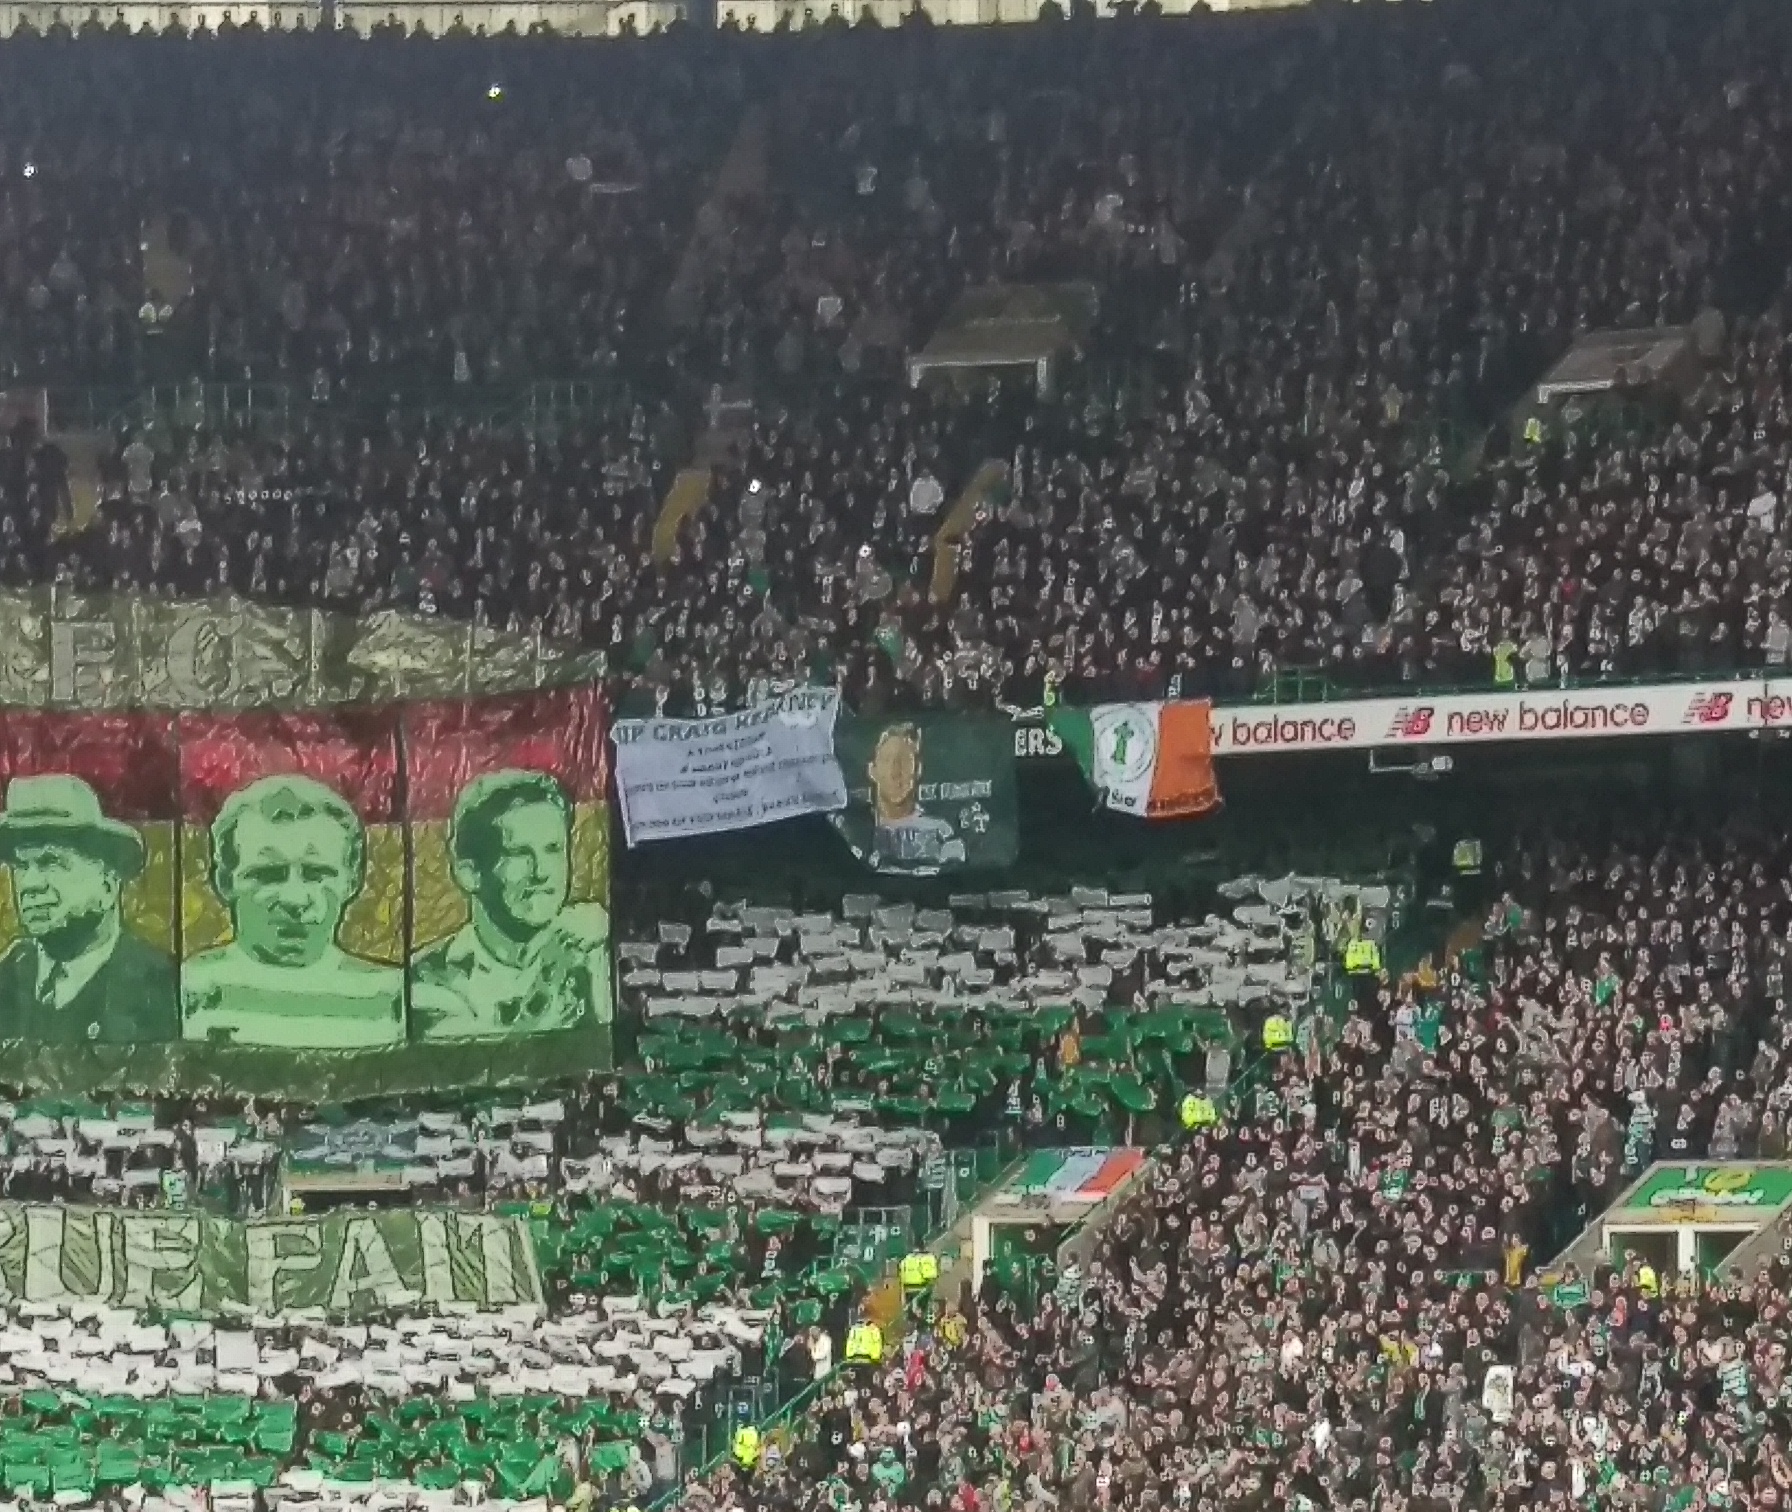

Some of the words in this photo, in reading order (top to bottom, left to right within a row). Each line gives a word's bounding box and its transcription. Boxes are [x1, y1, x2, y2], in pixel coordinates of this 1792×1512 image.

[1232, 714, 1355, 745] balance
[1447, 708, 1509, 738] new
[1519, 699, 1649, 732] balance
